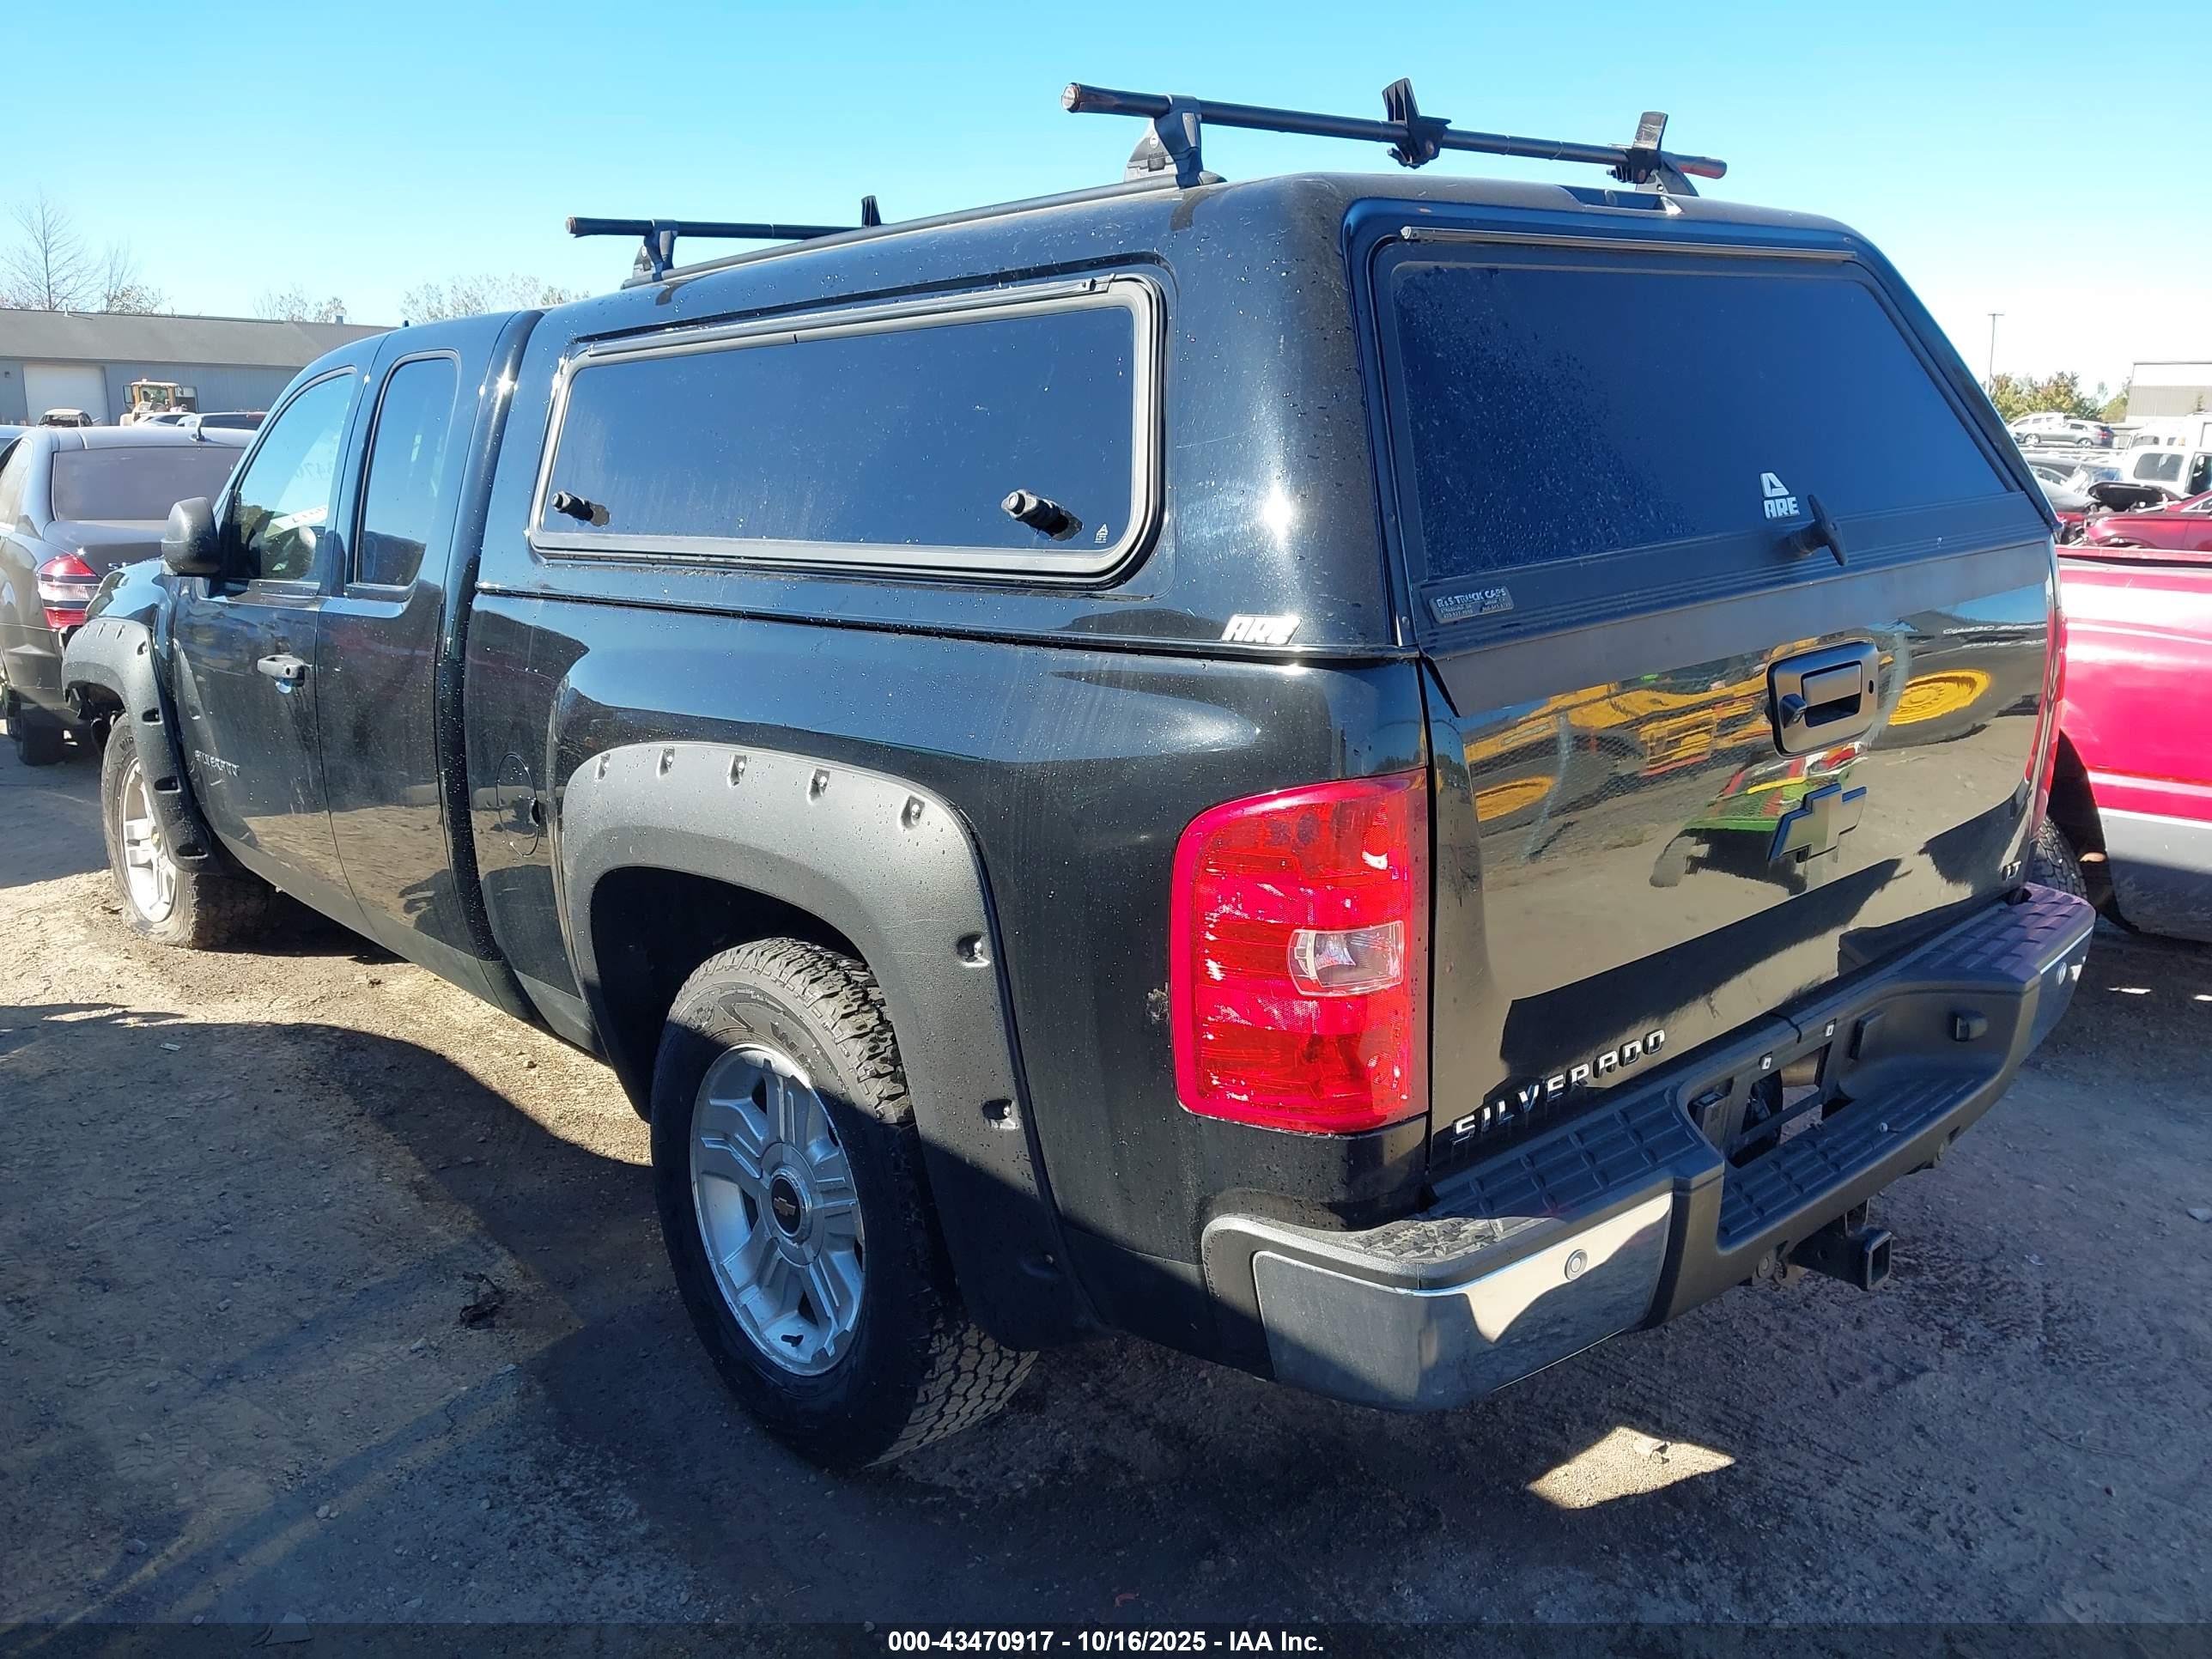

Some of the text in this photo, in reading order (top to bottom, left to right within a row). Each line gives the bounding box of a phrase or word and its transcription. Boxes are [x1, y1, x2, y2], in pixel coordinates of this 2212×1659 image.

[1763, 496, 1800, 519] ARE
[1454, 591, 1485, 605] TRUCK
[1485, 587, 1506, 599] CAPS
[1449, 1030, 1665, 1146] SILVERADO
